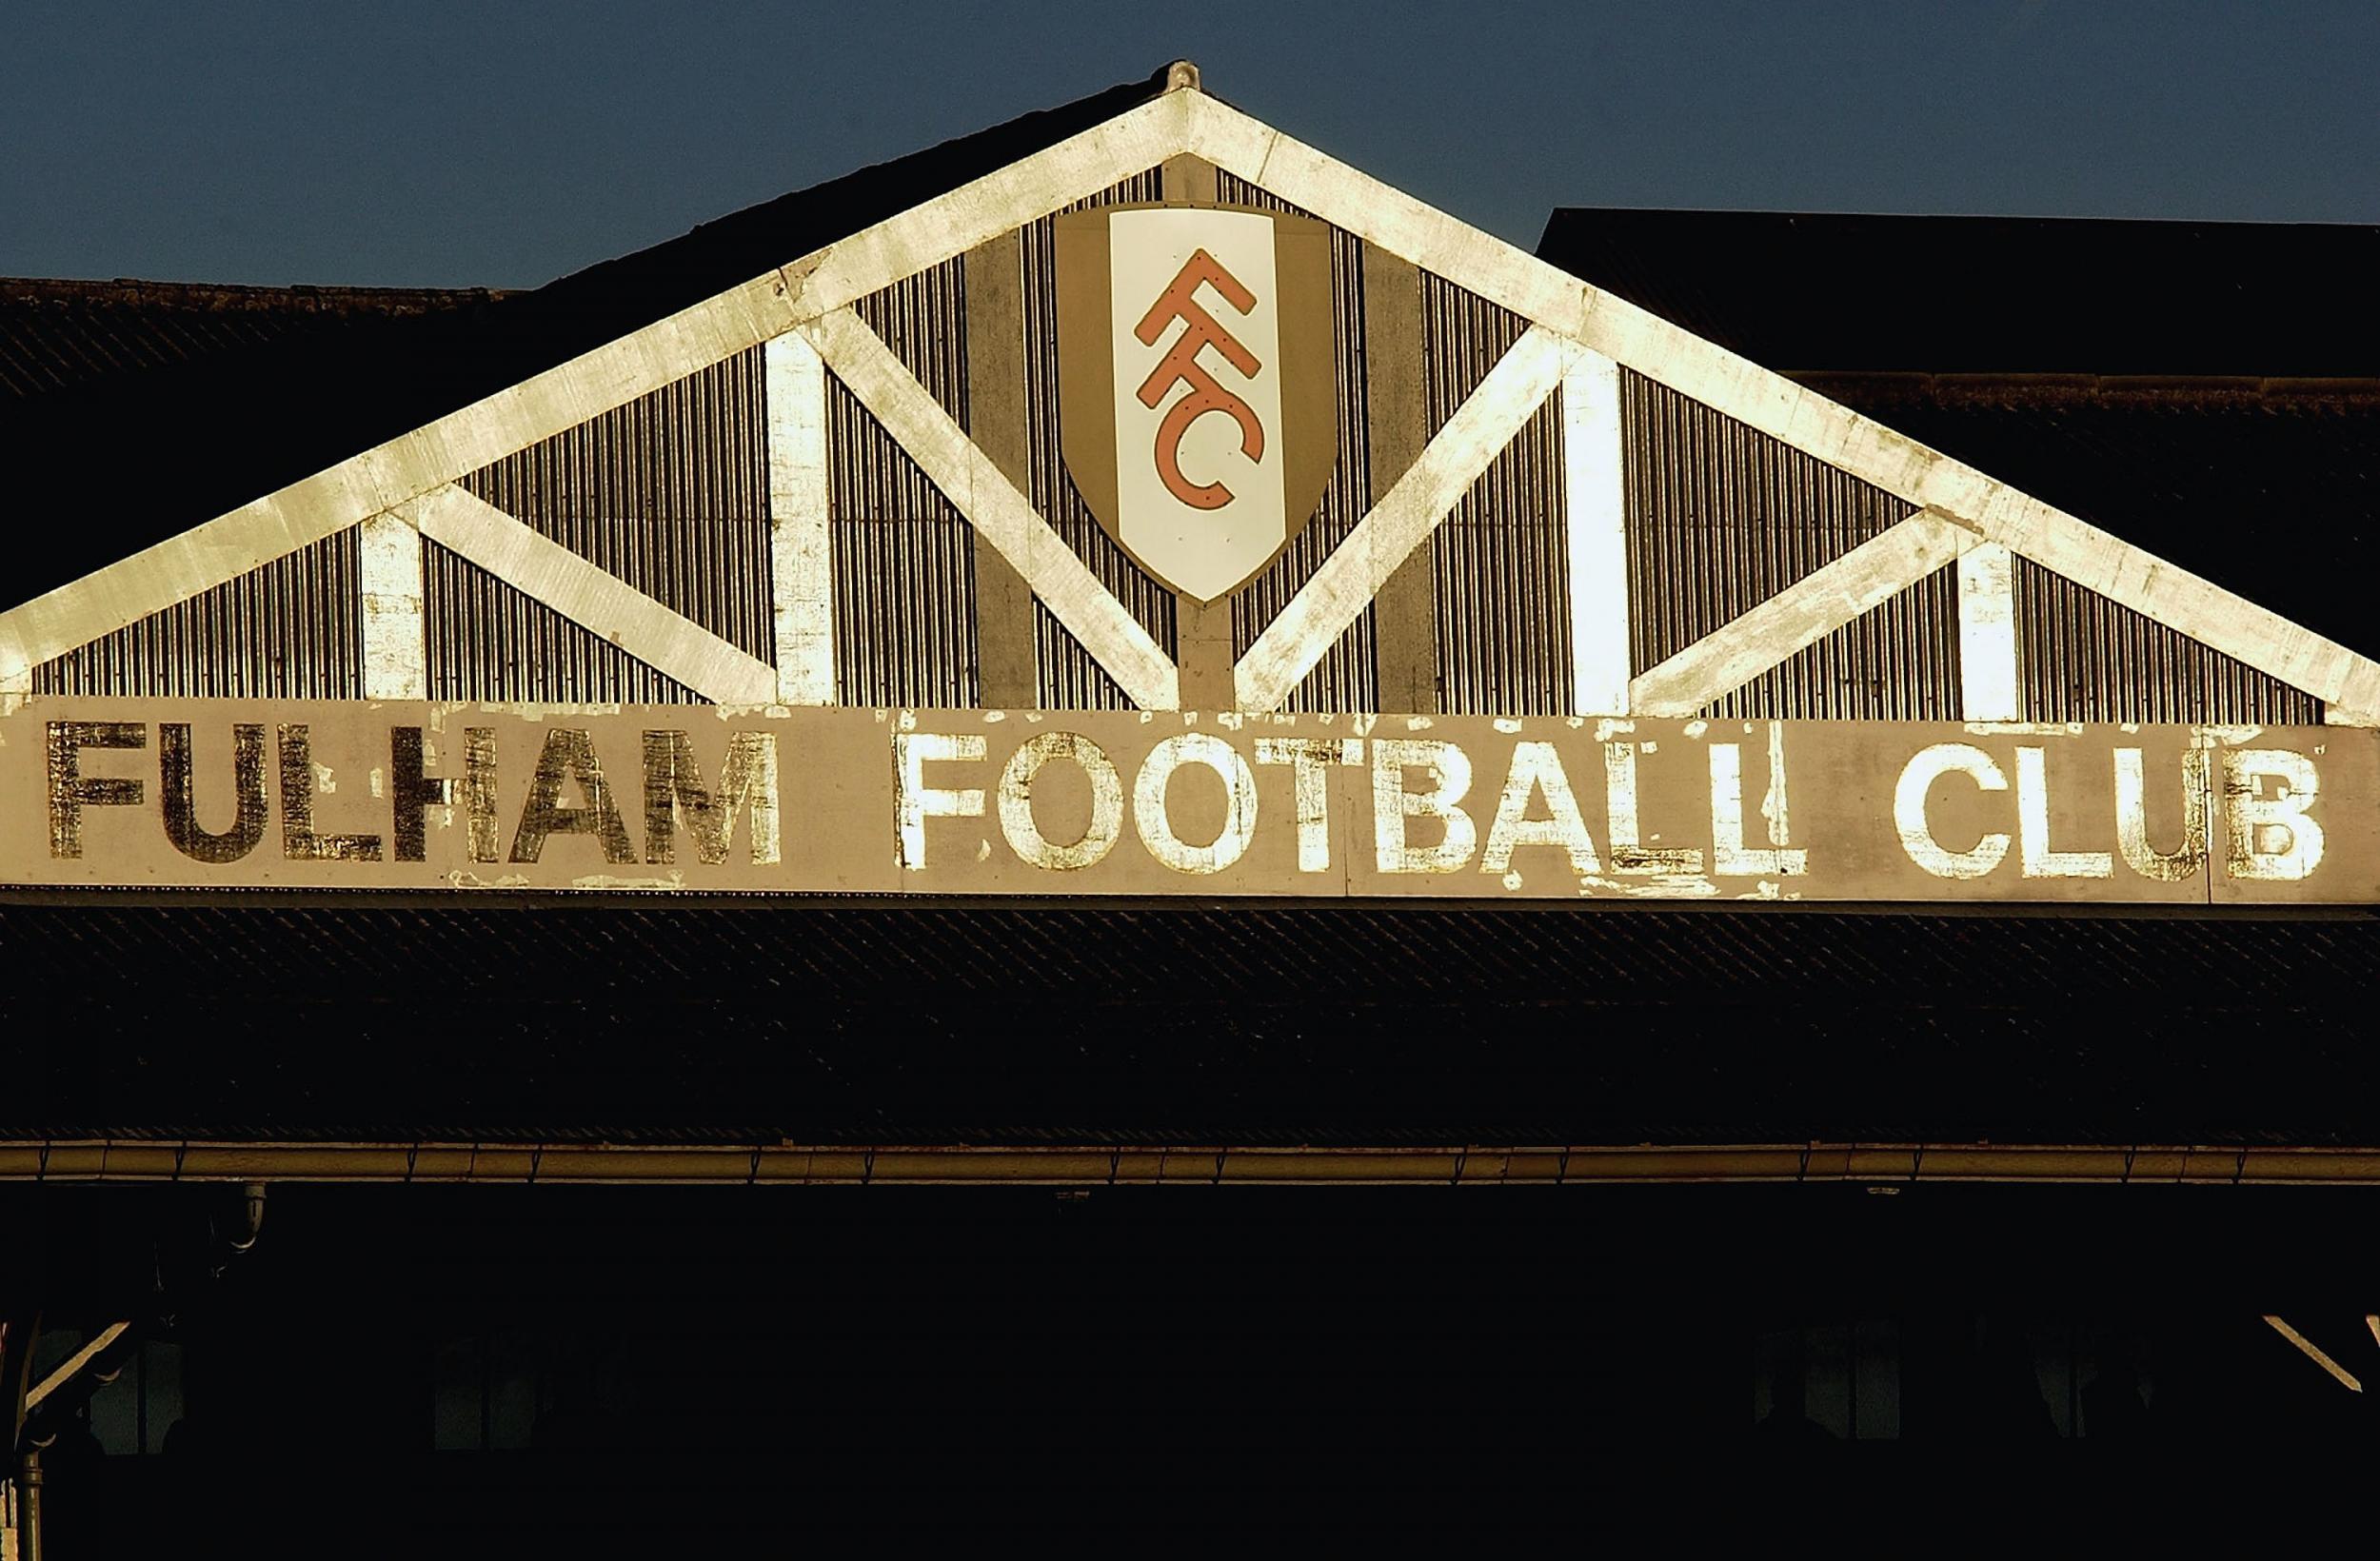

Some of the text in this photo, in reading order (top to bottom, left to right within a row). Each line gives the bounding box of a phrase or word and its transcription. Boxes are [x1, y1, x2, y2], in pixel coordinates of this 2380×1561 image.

[1134, 247, 1264, 510] FFC
[46, 721, 2326, 881] FULHAM FOOTBALL CLUB
